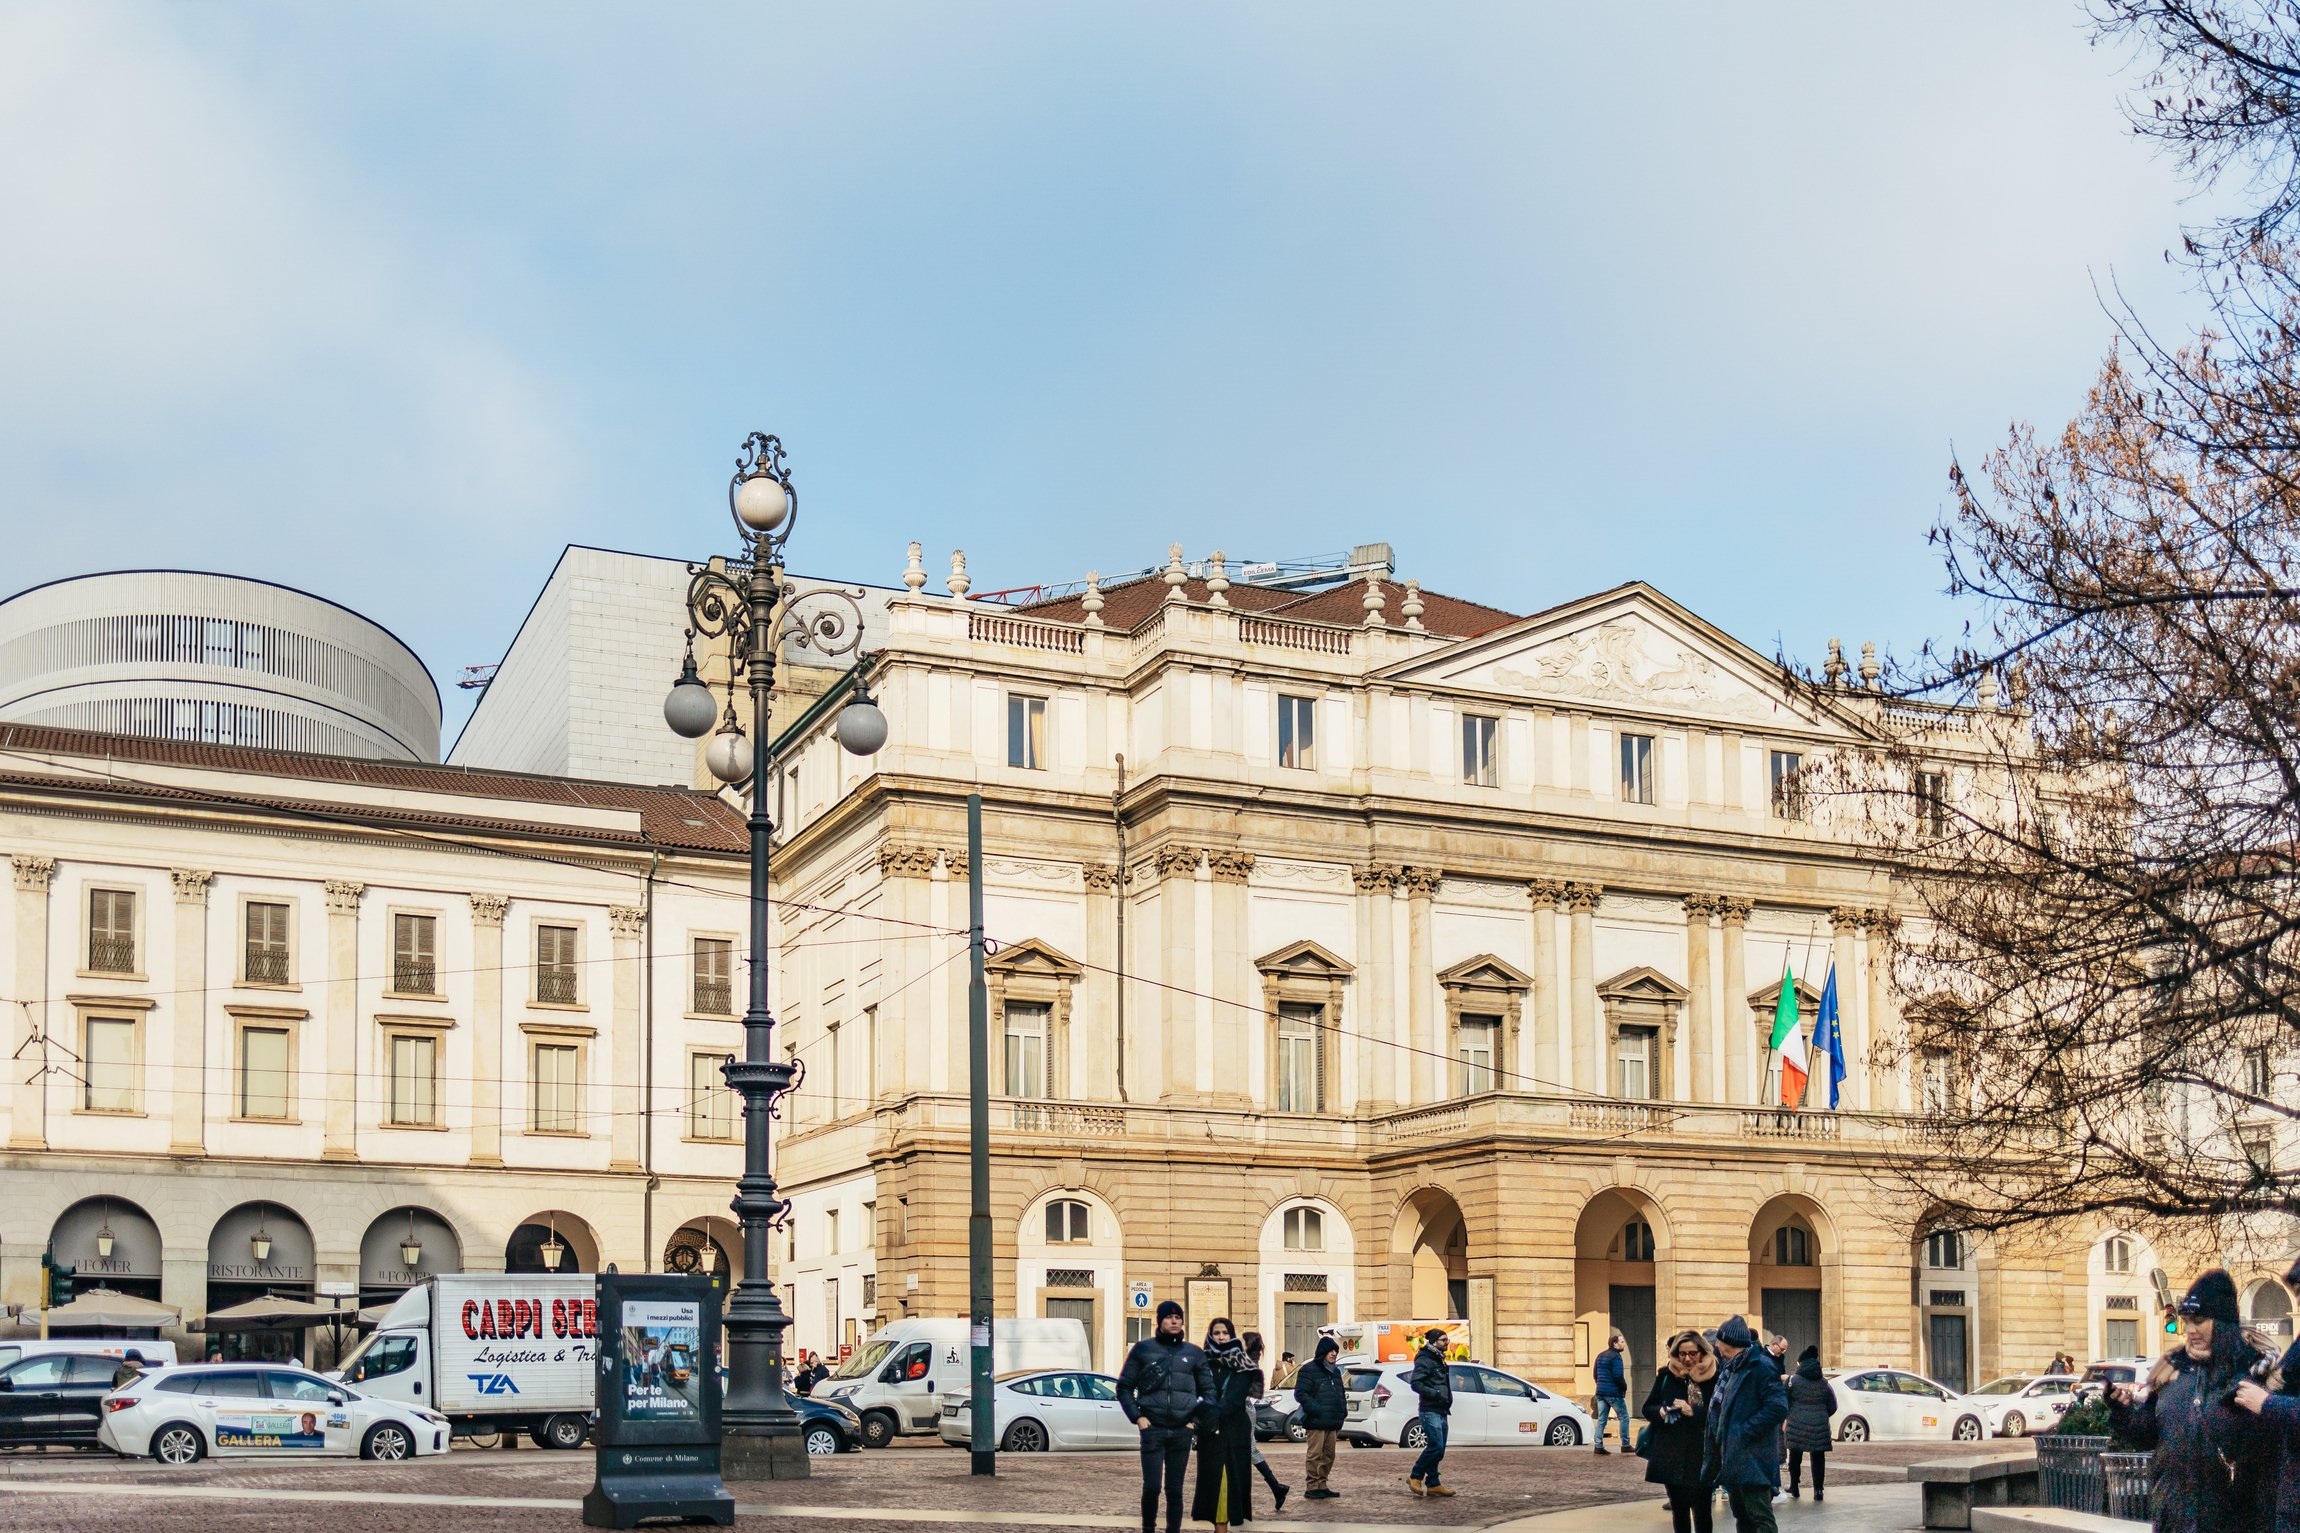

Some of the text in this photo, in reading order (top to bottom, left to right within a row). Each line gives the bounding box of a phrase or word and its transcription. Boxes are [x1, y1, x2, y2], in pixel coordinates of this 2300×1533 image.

[84, 1258, 131, 1272] FOYER
[212, 1264, 303, 1278] RISTORANTE
[462, 1299, 543, 1340] CARPI
[669, 1314, 694, 1322] pubblici
[2256, 1323, 2279, 1331] FENDI
[473, 1346, 547, 1368] Logistica
[553, 1349, 565, 1362] &
[628, 1384, 663, 1396] Per te
[628, 1397, 688, 1411] per Milano
[218, 1435, 282, 1447] GALLERA
[665, 1454, 673, 1462] di
[675, 1454, 699, 1462] Milano
